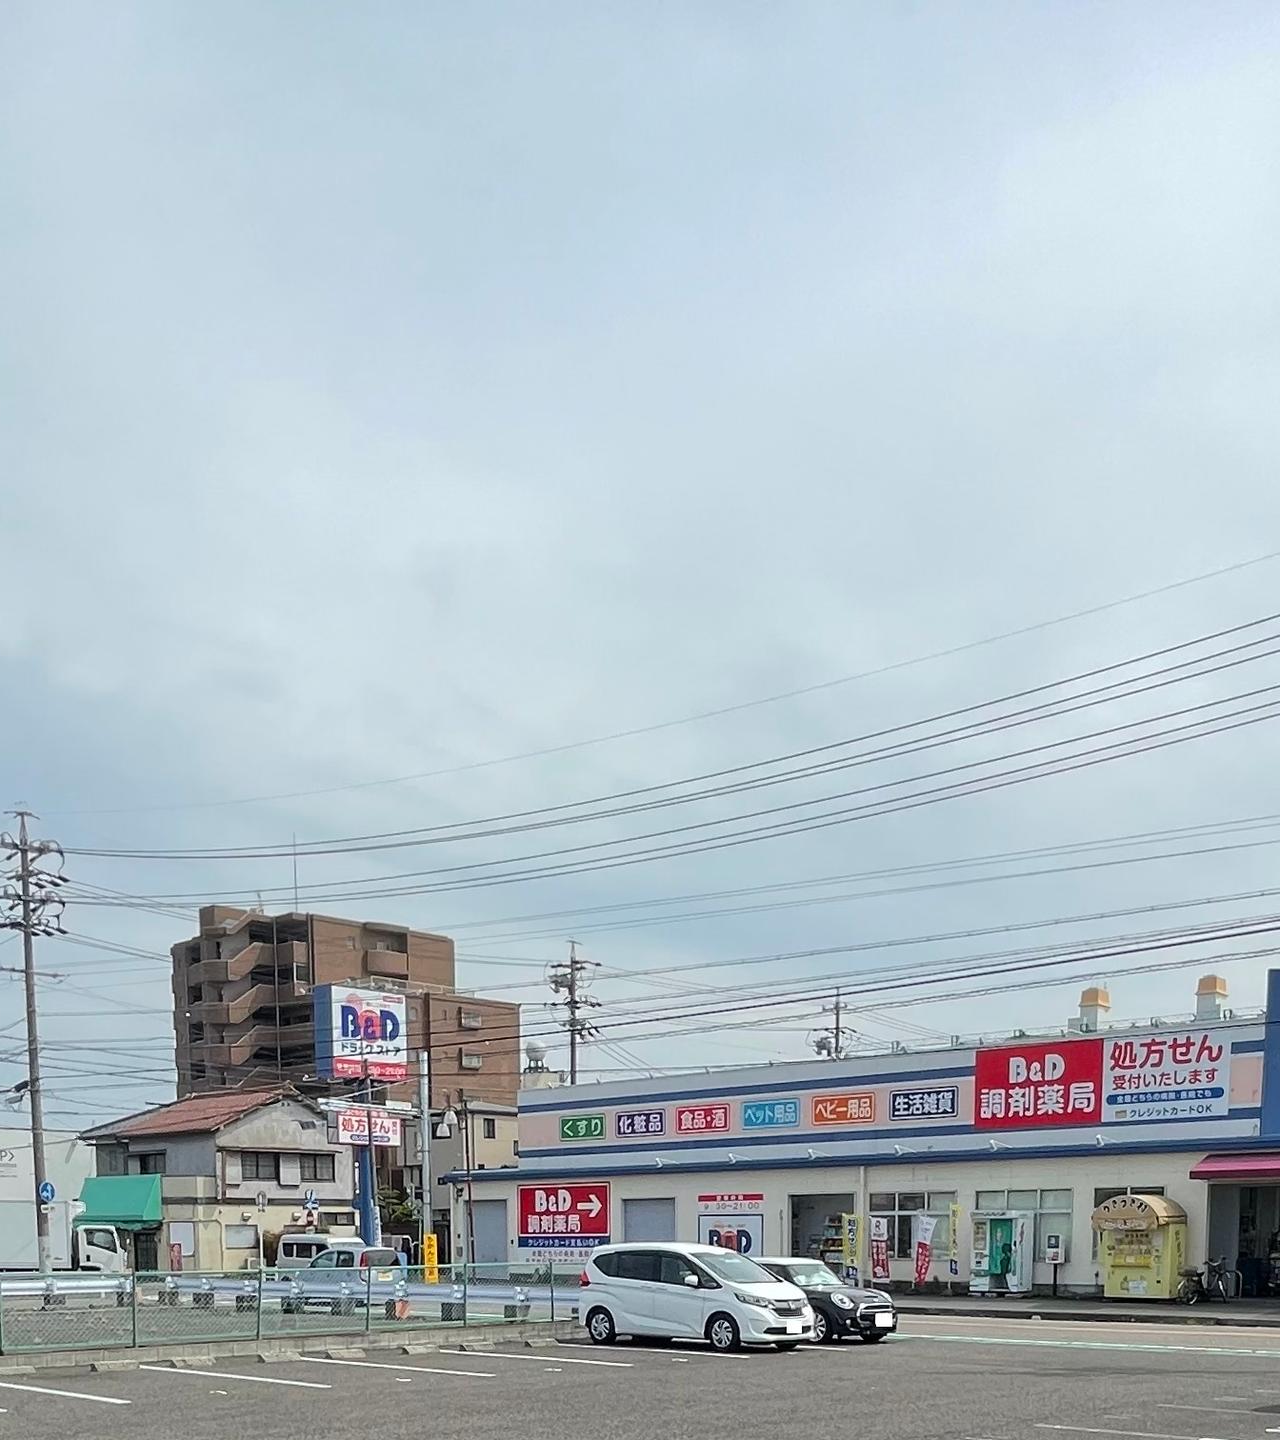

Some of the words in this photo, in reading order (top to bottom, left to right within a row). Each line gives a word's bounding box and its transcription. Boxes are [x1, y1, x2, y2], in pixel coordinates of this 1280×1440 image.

[341, 1005, 400, 1042] B&D
[1110, 1034, 1223, 1071] 処方せん
[1009, 1053, 1066, 1083] B&D
[1112, 1067, 1219, 1091] 受付いたします
[815, 1098, 871, 1120] ベビー用品
[894, 1093, 953, 1116] 生活雑貨
[980, 1082, 1095, 1119] 調剤薬局
[1129, 1104, 1213, 1119] クレジットカードOK
[342, 1117, 390, 1134] 処方せん
[619, 1114, 662, 1133] 化粧品
[680, 1108, 725, 1131] 食品・酒
[744, 1105, 796, 1125] ペット用品
[562, 1118, 602, 1137] くすり
[534, 1189, 572, 1212] B&D
[527, 1214, 581, 1233] 調剤薬局
